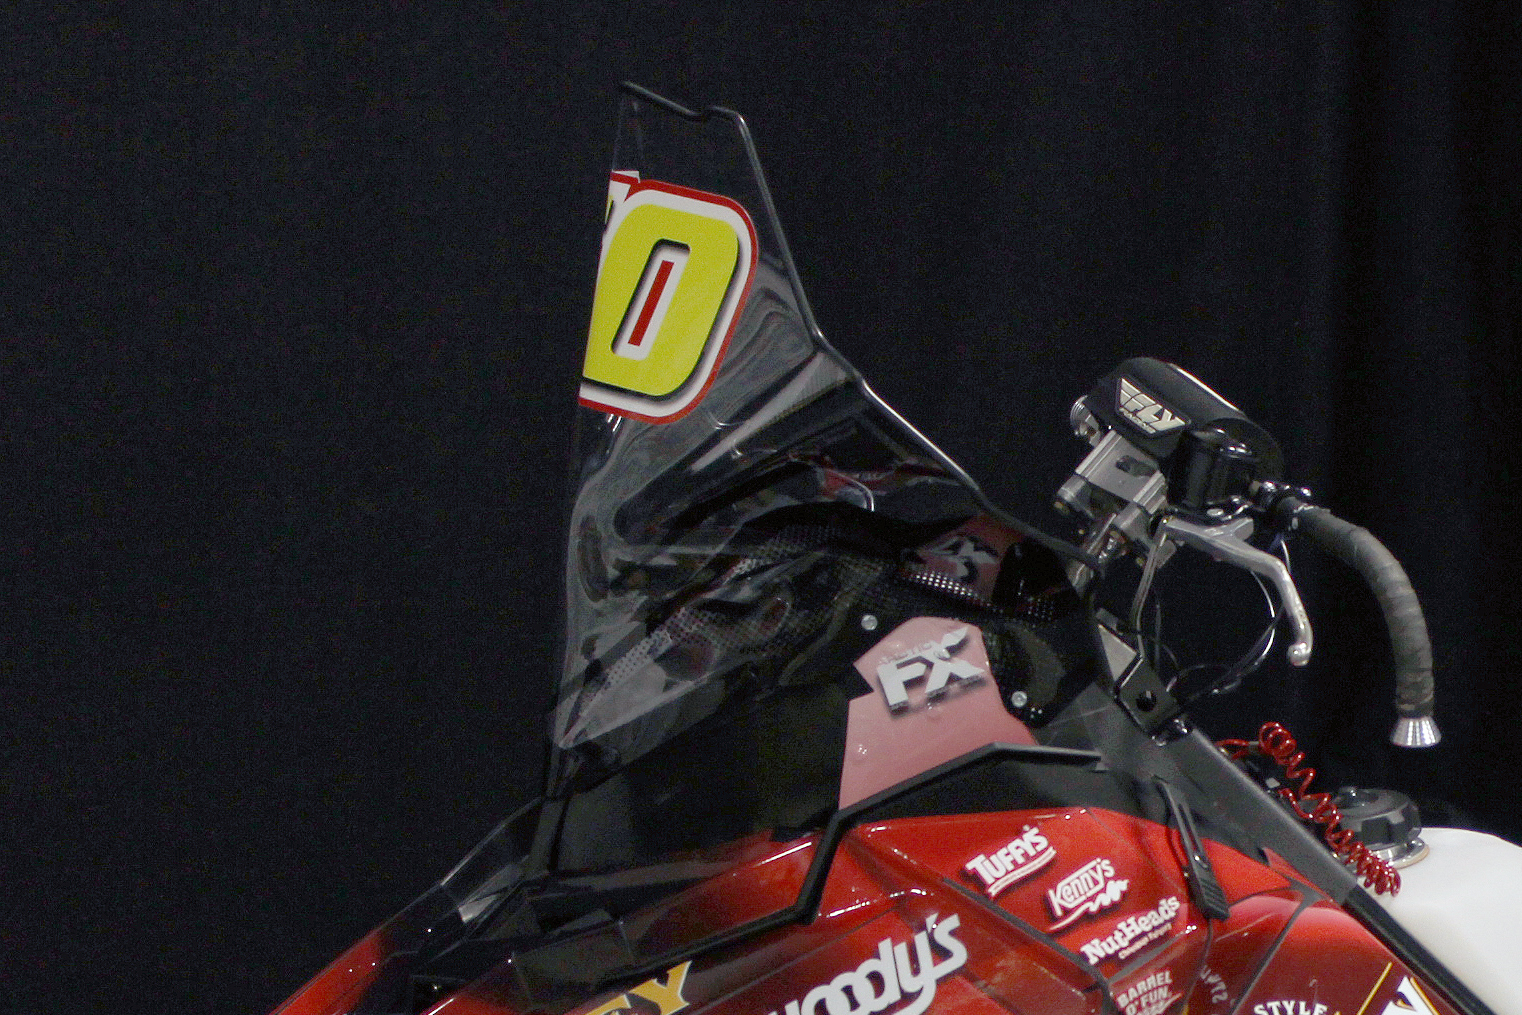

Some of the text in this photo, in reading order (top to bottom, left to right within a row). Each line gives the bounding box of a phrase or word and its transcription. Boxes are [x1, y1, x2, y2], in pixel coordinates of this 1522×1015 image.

[578, 170, 759, 425] 0
[876, 626, 985, 707] FX
[1048, 858, 1115, 917] Kenny's
[1080, 896, 1181, 965] NutHeads
[1117, 970, 1172, 1008] BARREL
